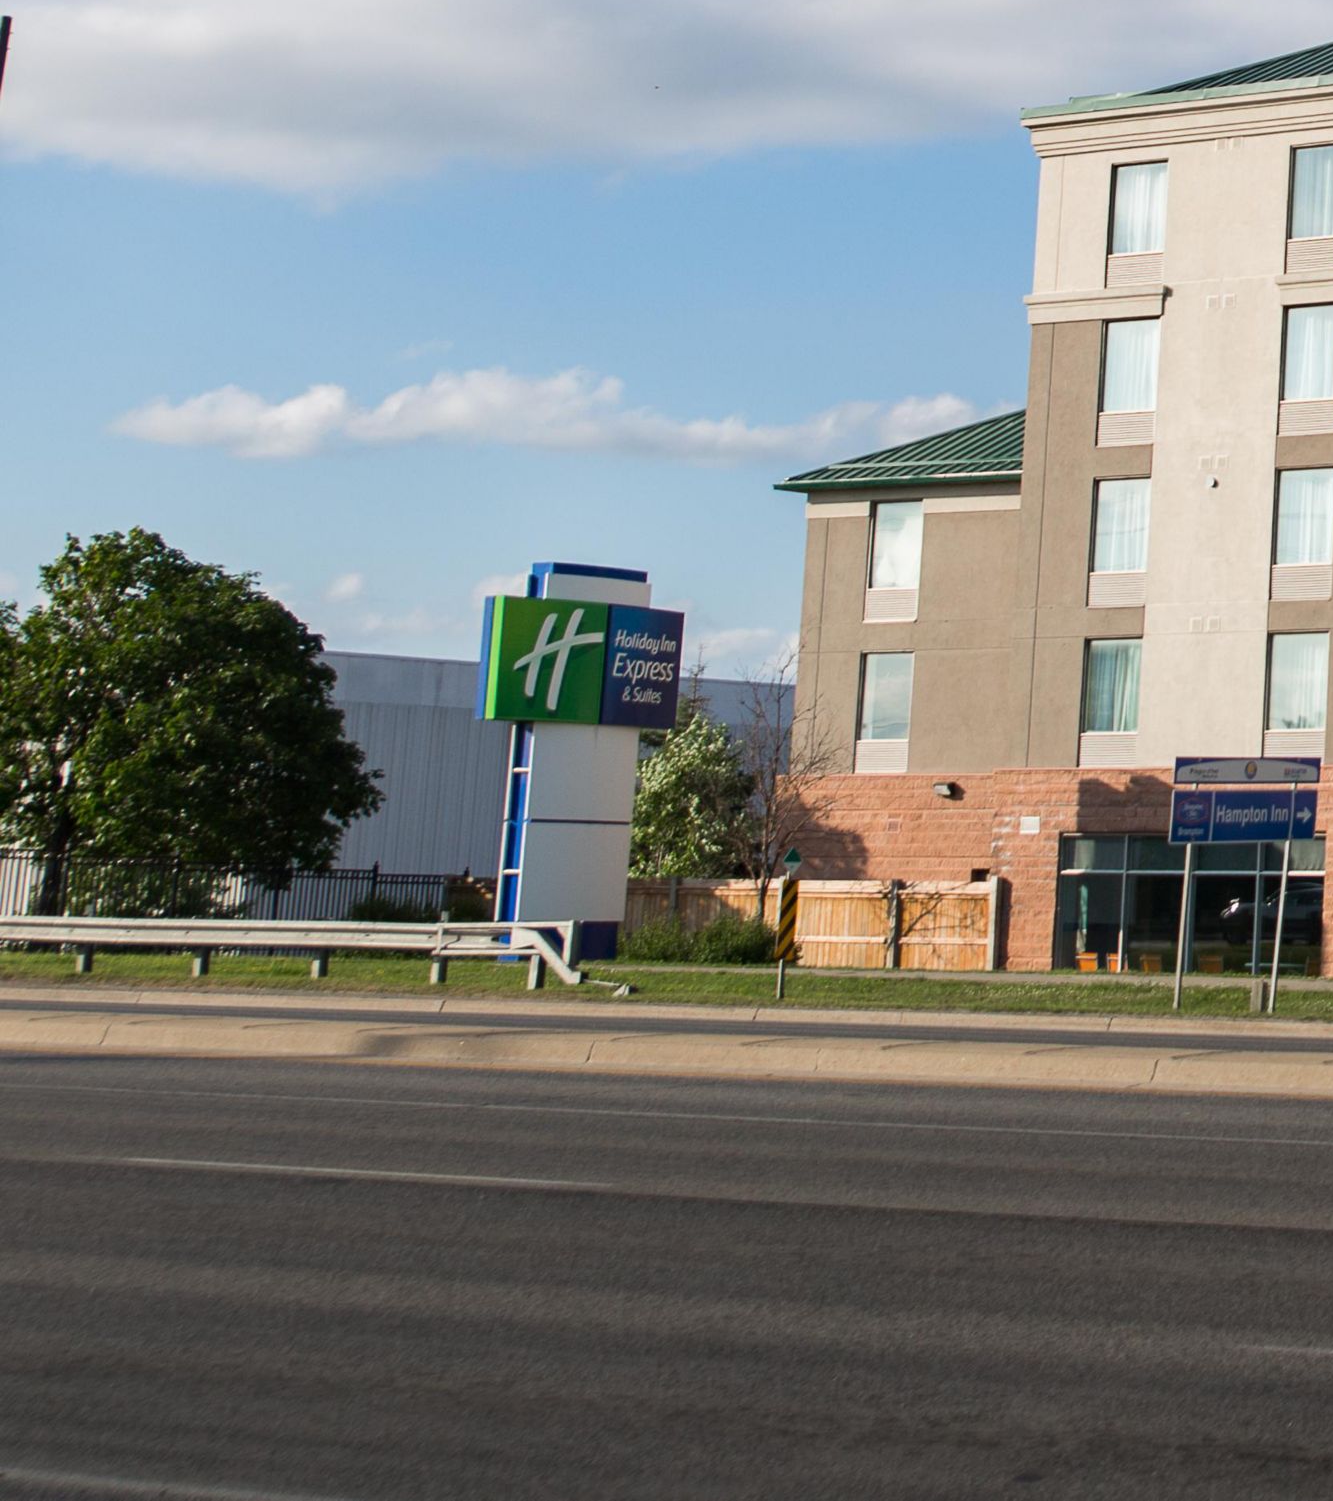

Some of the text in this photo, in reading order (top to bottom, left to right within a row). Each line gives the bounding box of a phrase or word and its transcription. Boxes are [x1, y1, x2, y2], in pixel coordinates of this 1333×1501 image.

[615, 629, 677, 655] Holiday Inn
[612, 652, 675, 685] Express
[622, 686, 663, 704] & Suites
[1215, 804, 1269, 827] Hampton
[1271, 804, 1289, 823] Inn
